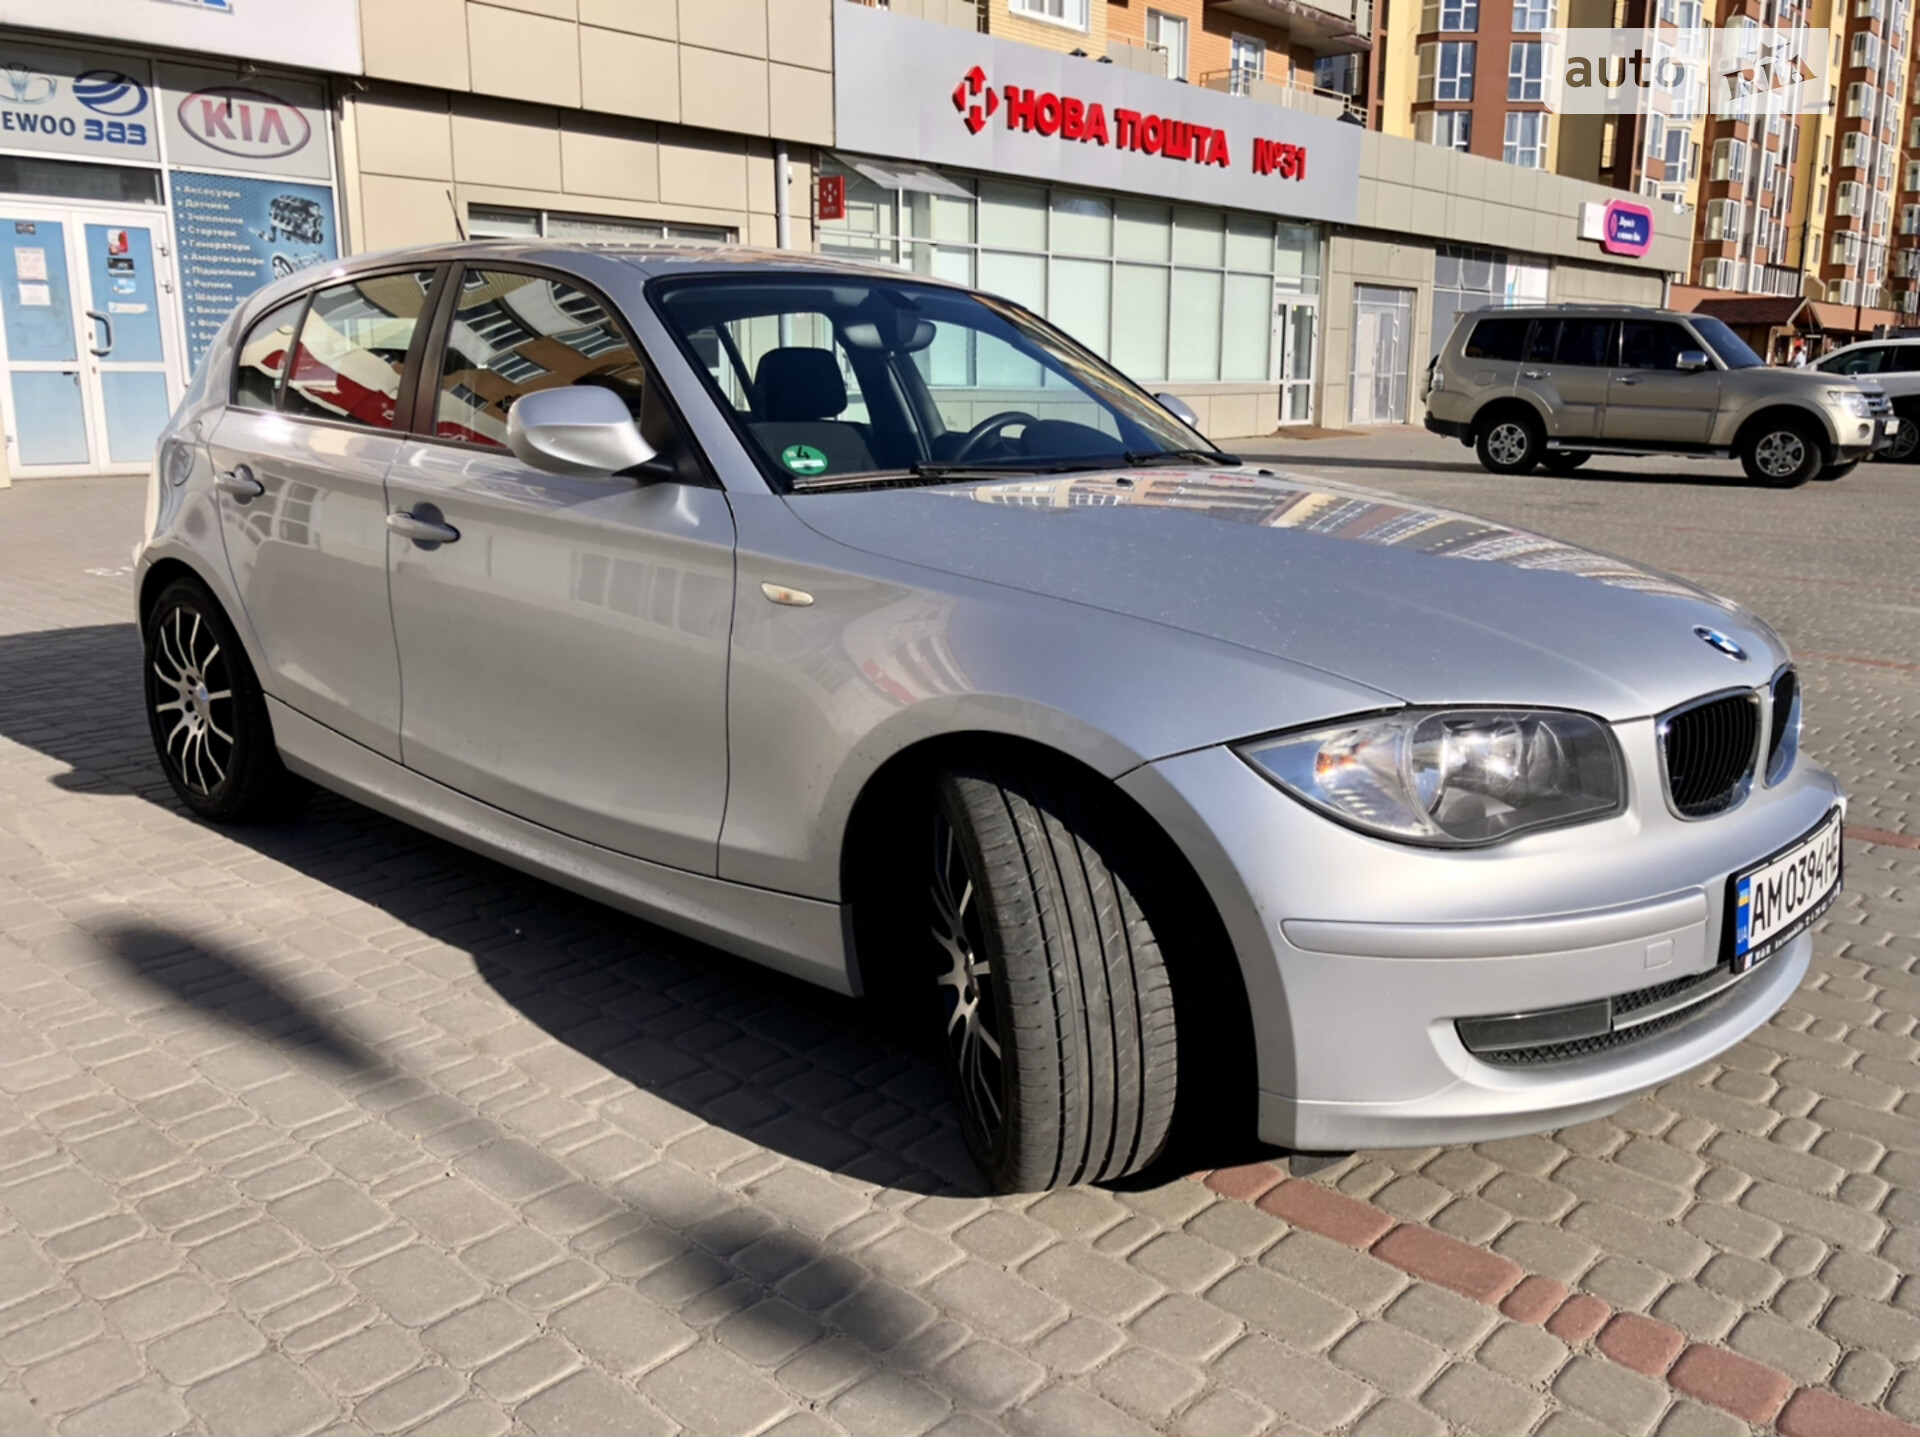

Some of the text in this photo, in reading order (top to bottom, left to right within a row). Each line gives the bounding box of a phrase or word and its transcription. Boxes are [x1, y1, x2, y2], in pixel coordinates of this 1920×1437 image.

[1, 110, 76, 137] EWOO
[200, 99, 292, 146] KIA
[1003, 85, 1307, 182] НОВА ПОШТА №31
[796, 445, 811, 460] 4
